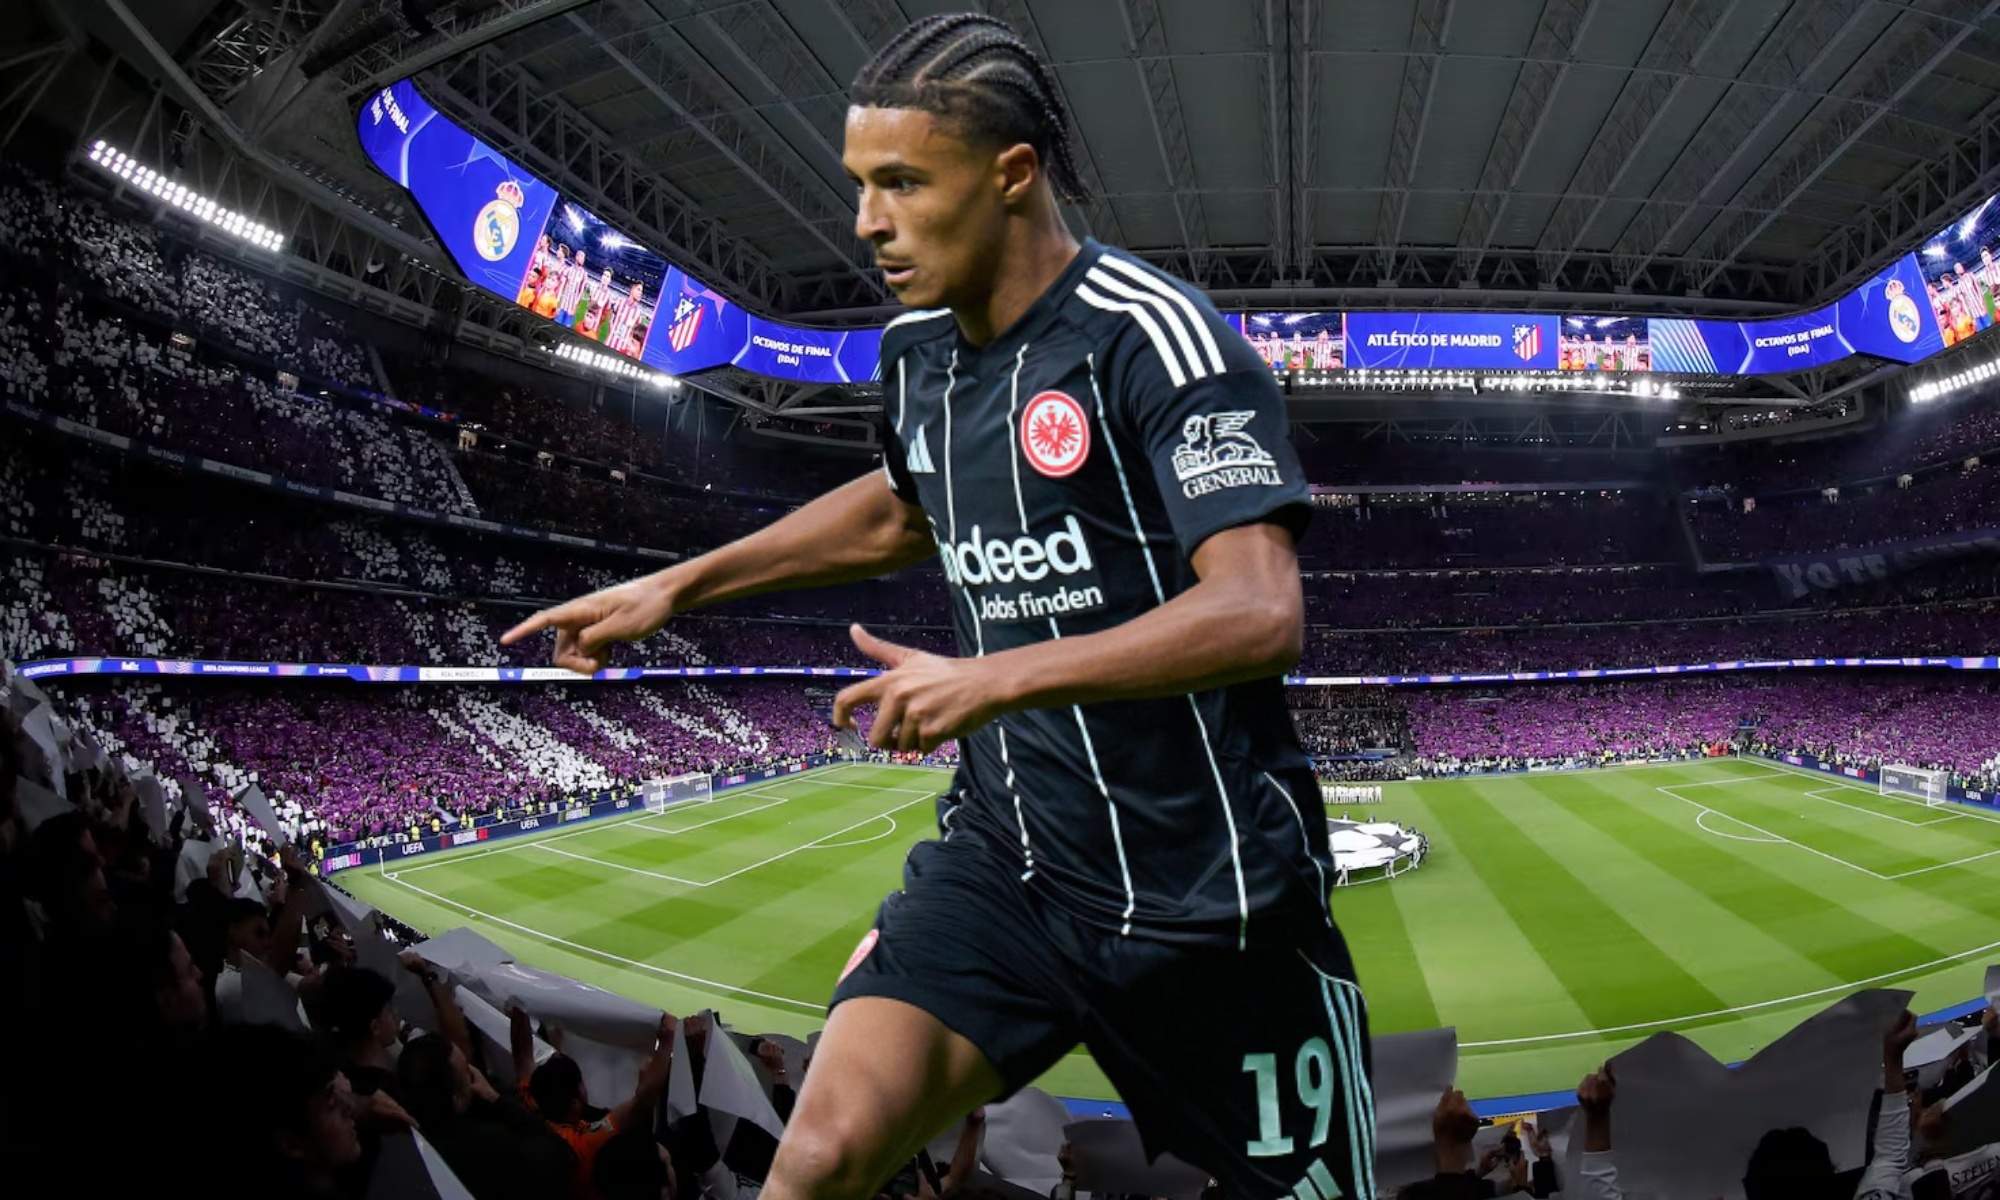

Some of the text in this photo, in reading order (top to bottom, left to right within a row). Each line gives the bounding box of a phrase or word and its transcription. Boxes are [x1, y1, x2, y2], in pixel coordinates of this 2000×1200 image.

[1367, 330, 1502, 346] ATLÉTICO DE MADRID
[1755, 324, 1834, 347] OCTAVOS DE FINAL
[753, 335, 832, 357] OCTAVOS DE FINAL
[1788, 343, 1809, 357] (IDA)
[777, 354, 799, 366] (IDA)
[1183, 466, 1284, 499] GENERALI
[980, 585, 1104, 620] Jobs finden
[519, 818, 540, 830] UEFA
[402, 842, 425, 855] UEFA
[1242, 1036, 1334, 1157] 19
